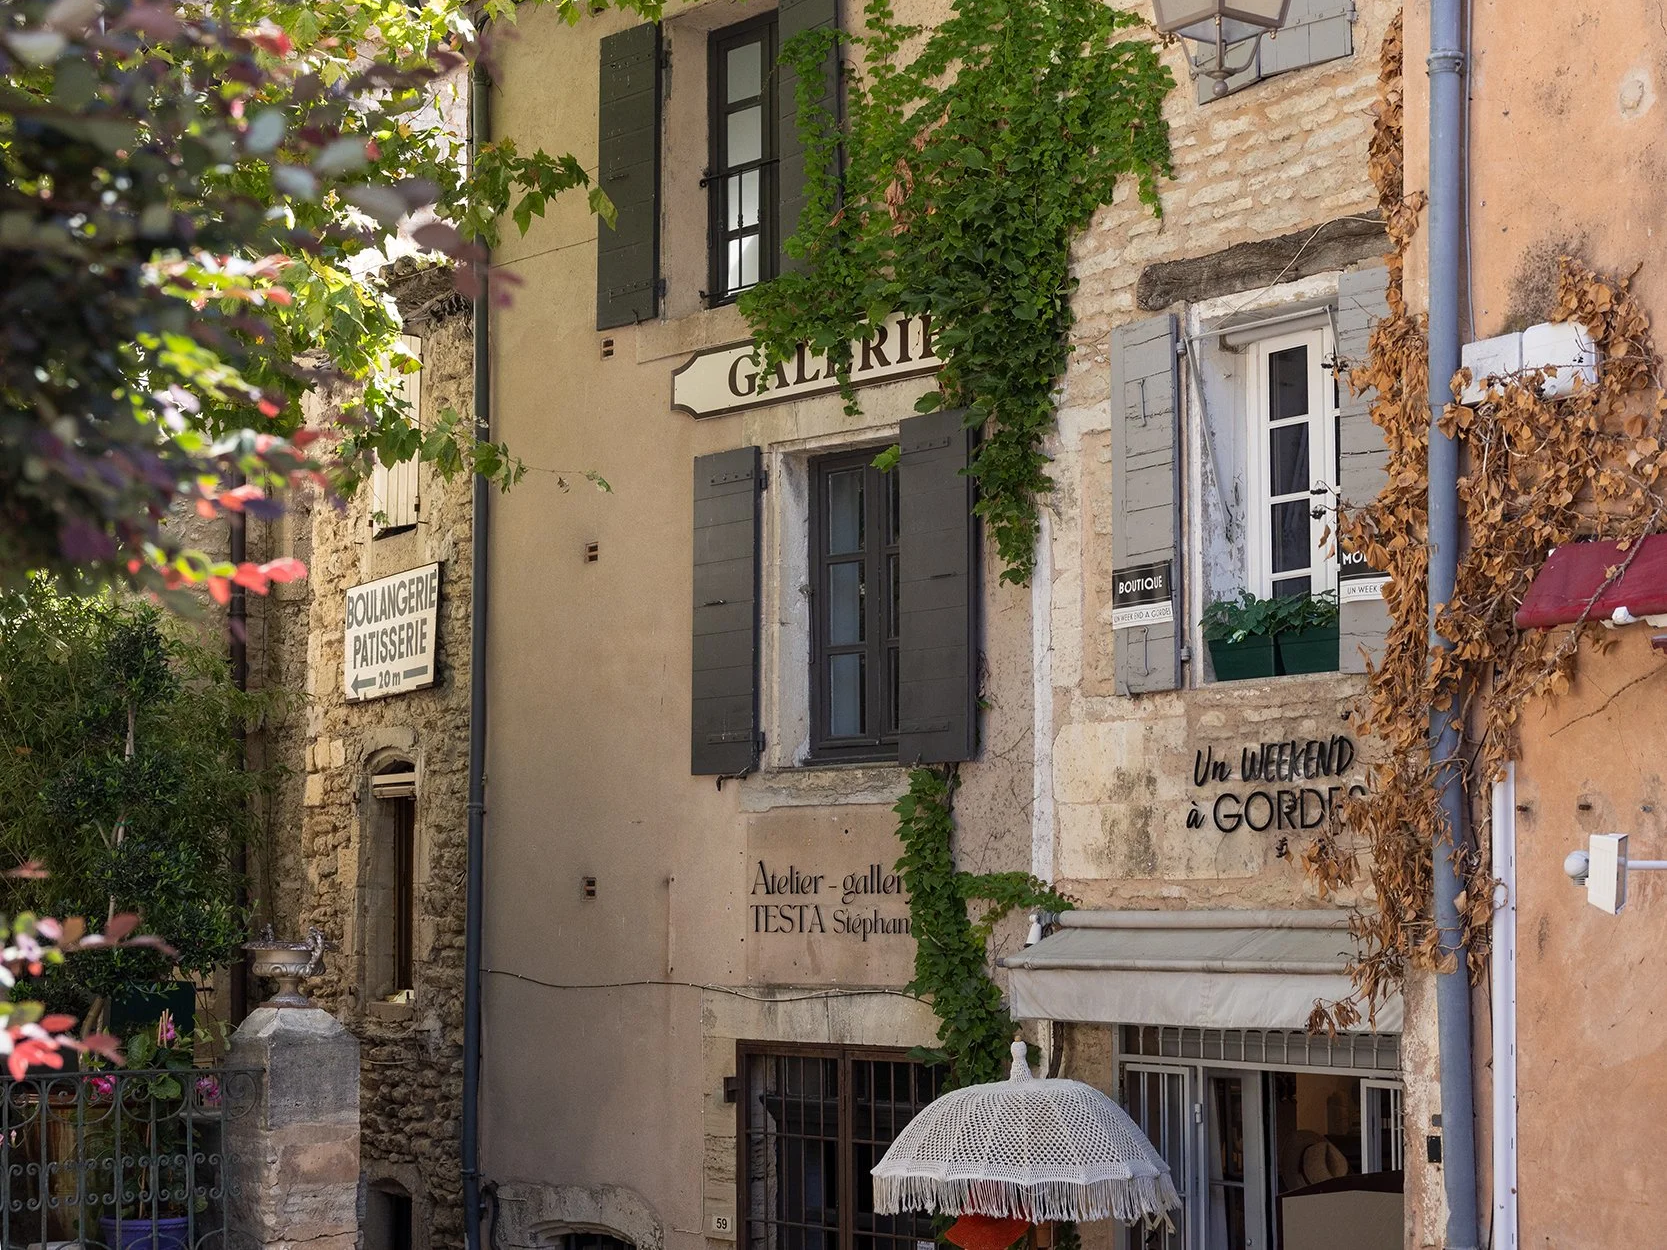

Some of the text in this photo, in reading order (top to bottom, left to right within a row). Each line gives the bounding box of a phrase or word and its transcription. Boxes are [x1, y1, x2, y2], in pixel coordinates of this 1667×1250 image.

[346, 571, 437, 630] BOULANGERIE
[1118, 575, 1163, 595] BOUTIQUE
[1347, 587, 1357, 595] UN
[1358, 584, 1378, 594] WEEK
[353, 617, 428, 669] PATISSERIE
[378, 669, 401, 689] 20 m
[1194, 734, 1354, 787] Un WEEKEND
[1186, 801, 1206, 829] à
[751, 860, 824, 895] Atelier
[841, 863, 912, 905] galler
[750, 904, 913, 942] TESTA Stéphan
[716, 1217, 728, 1230] 59
